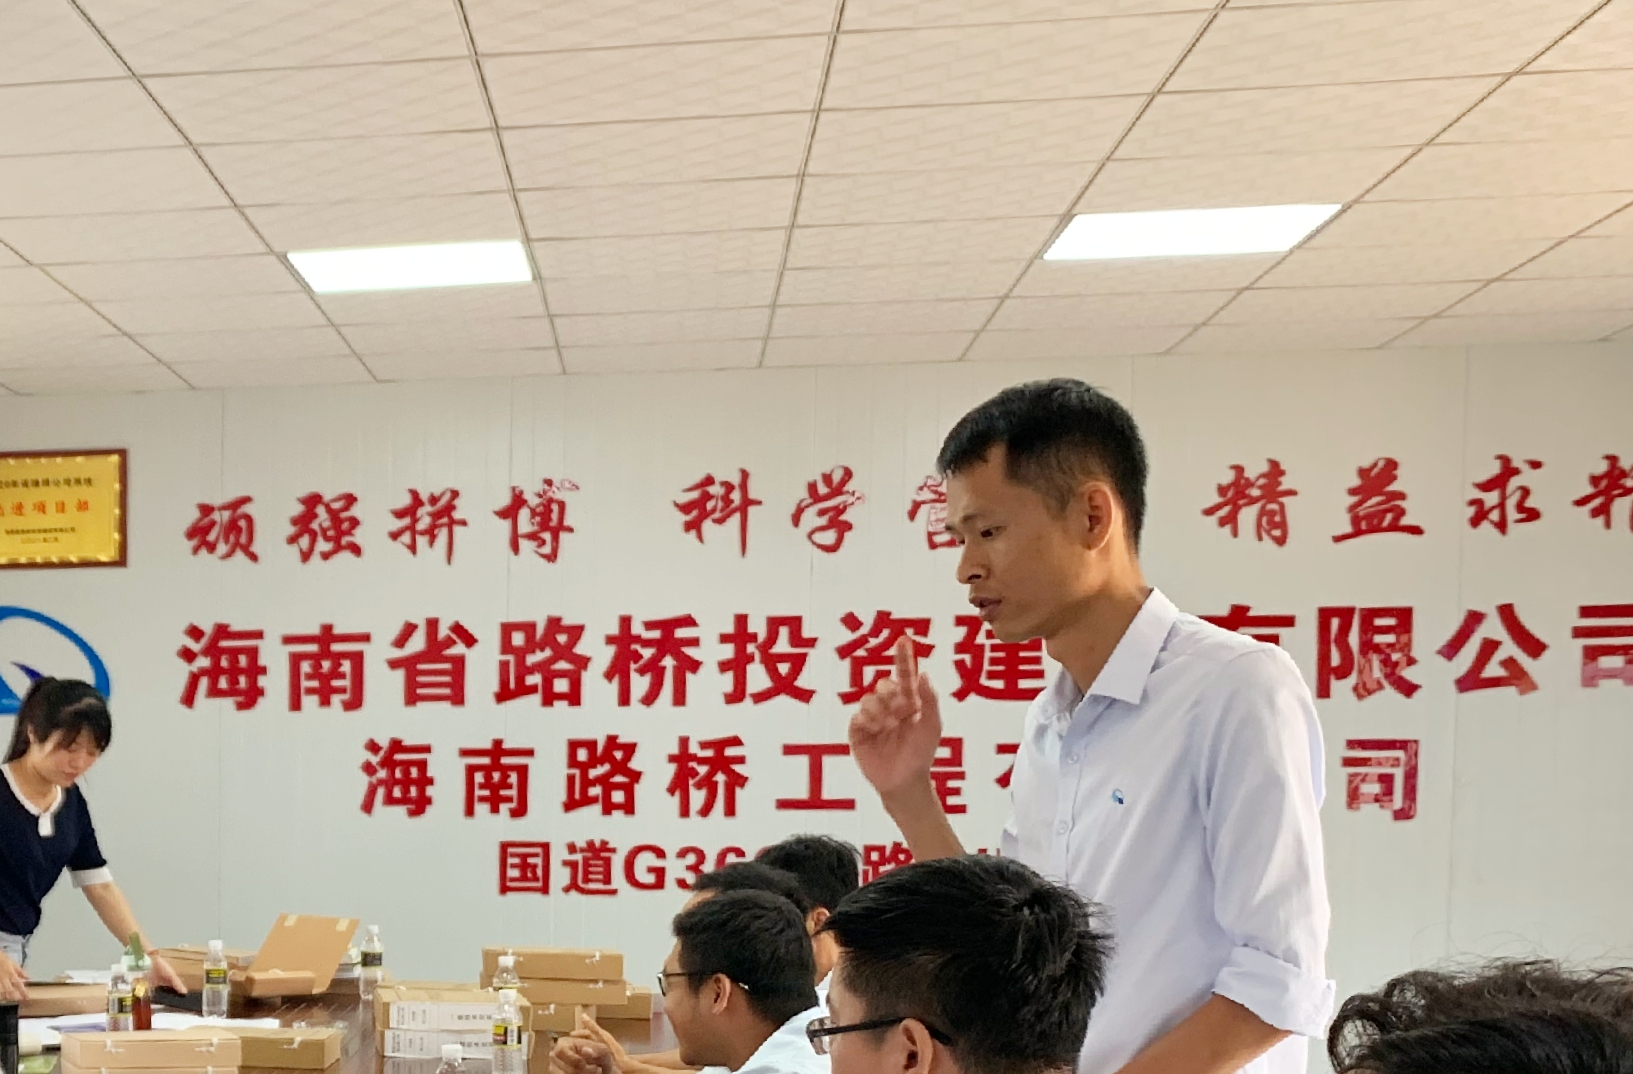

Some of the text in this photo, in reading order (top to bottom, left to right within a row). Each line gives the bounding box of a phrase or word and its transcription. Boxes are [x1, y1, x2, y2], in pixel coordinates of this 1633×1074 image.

[185, 478, 576, 565] 顽强拼搏
[1202, 454, 1633, 548] 精益求精
